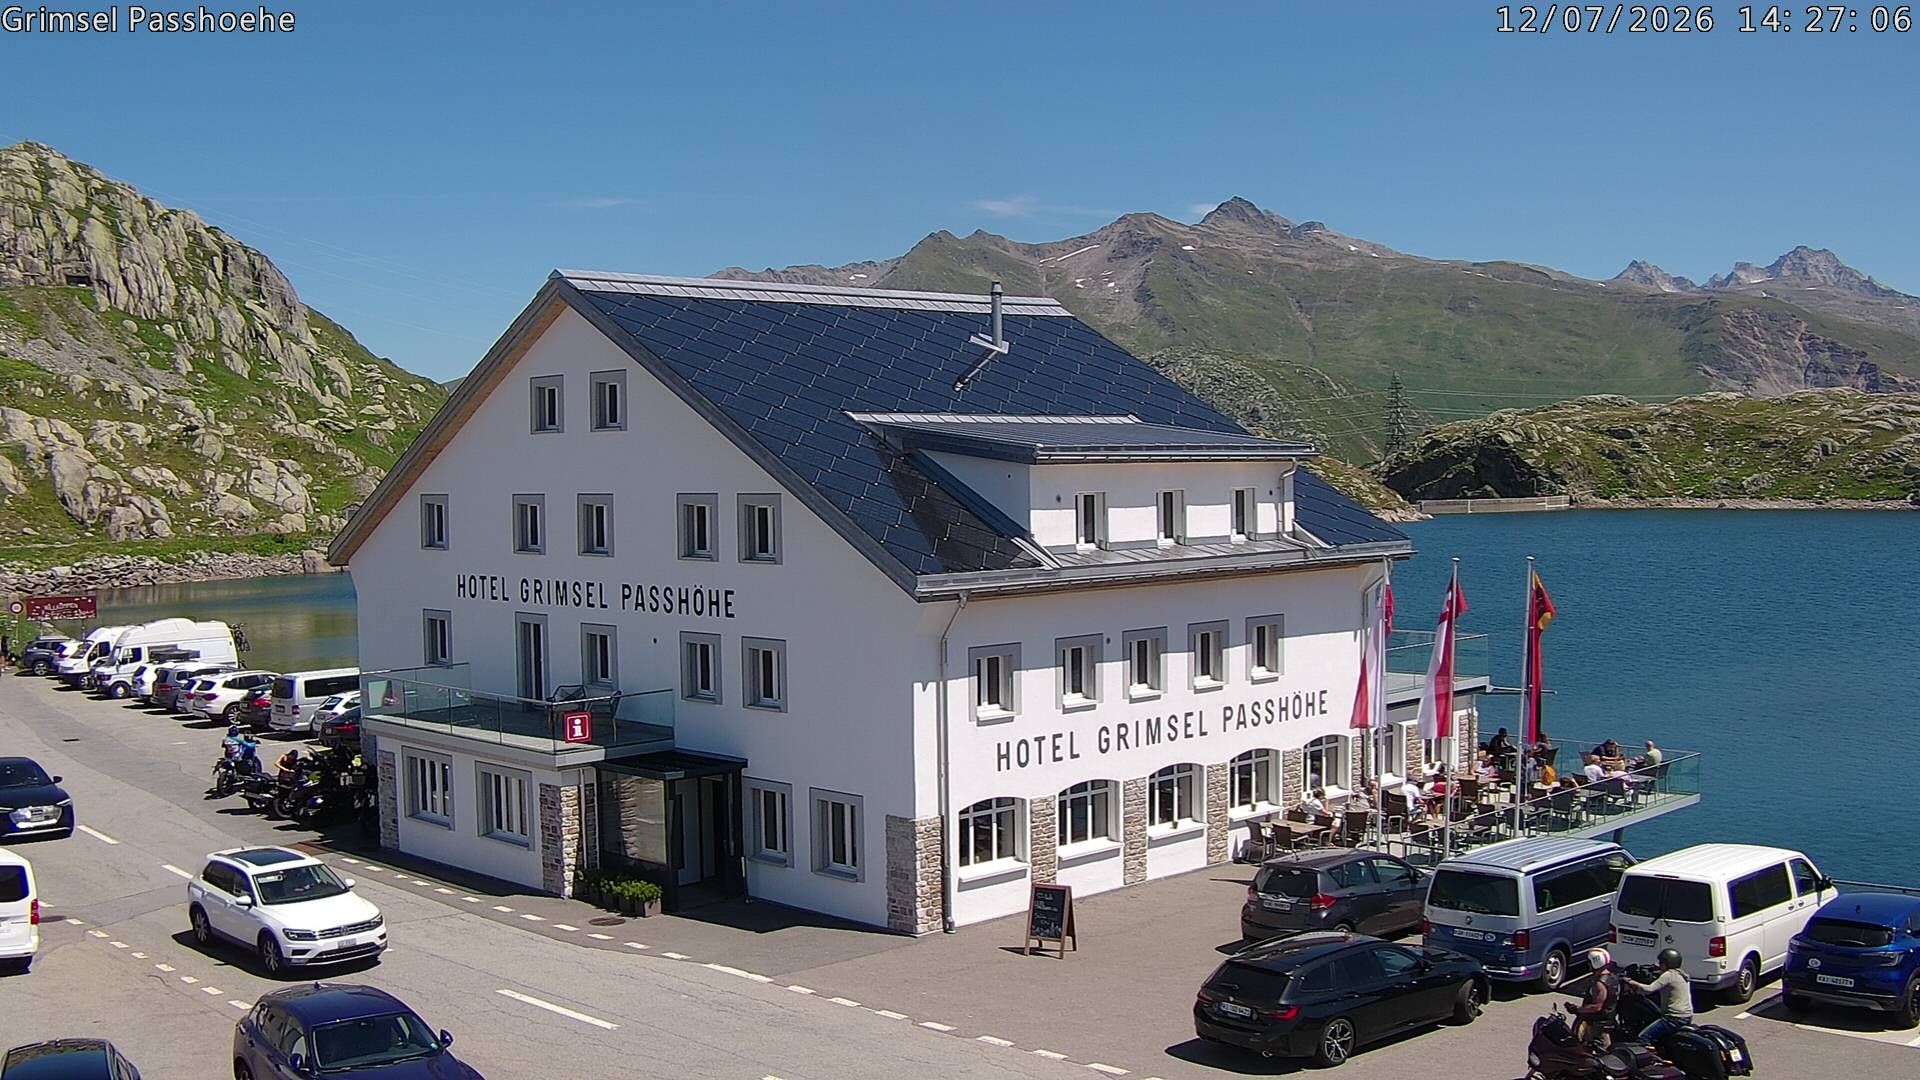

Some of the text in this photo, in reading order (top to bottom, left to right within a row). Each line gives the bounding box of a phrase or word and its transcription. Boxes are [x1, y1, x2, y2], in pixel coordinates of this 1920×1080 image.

[457, 574, 735, 618] HOTEL GRIMSEL PASSHÖHE
[997, 690, 1328, 772] HOTEL GRIMSEL PASSHÖHE
